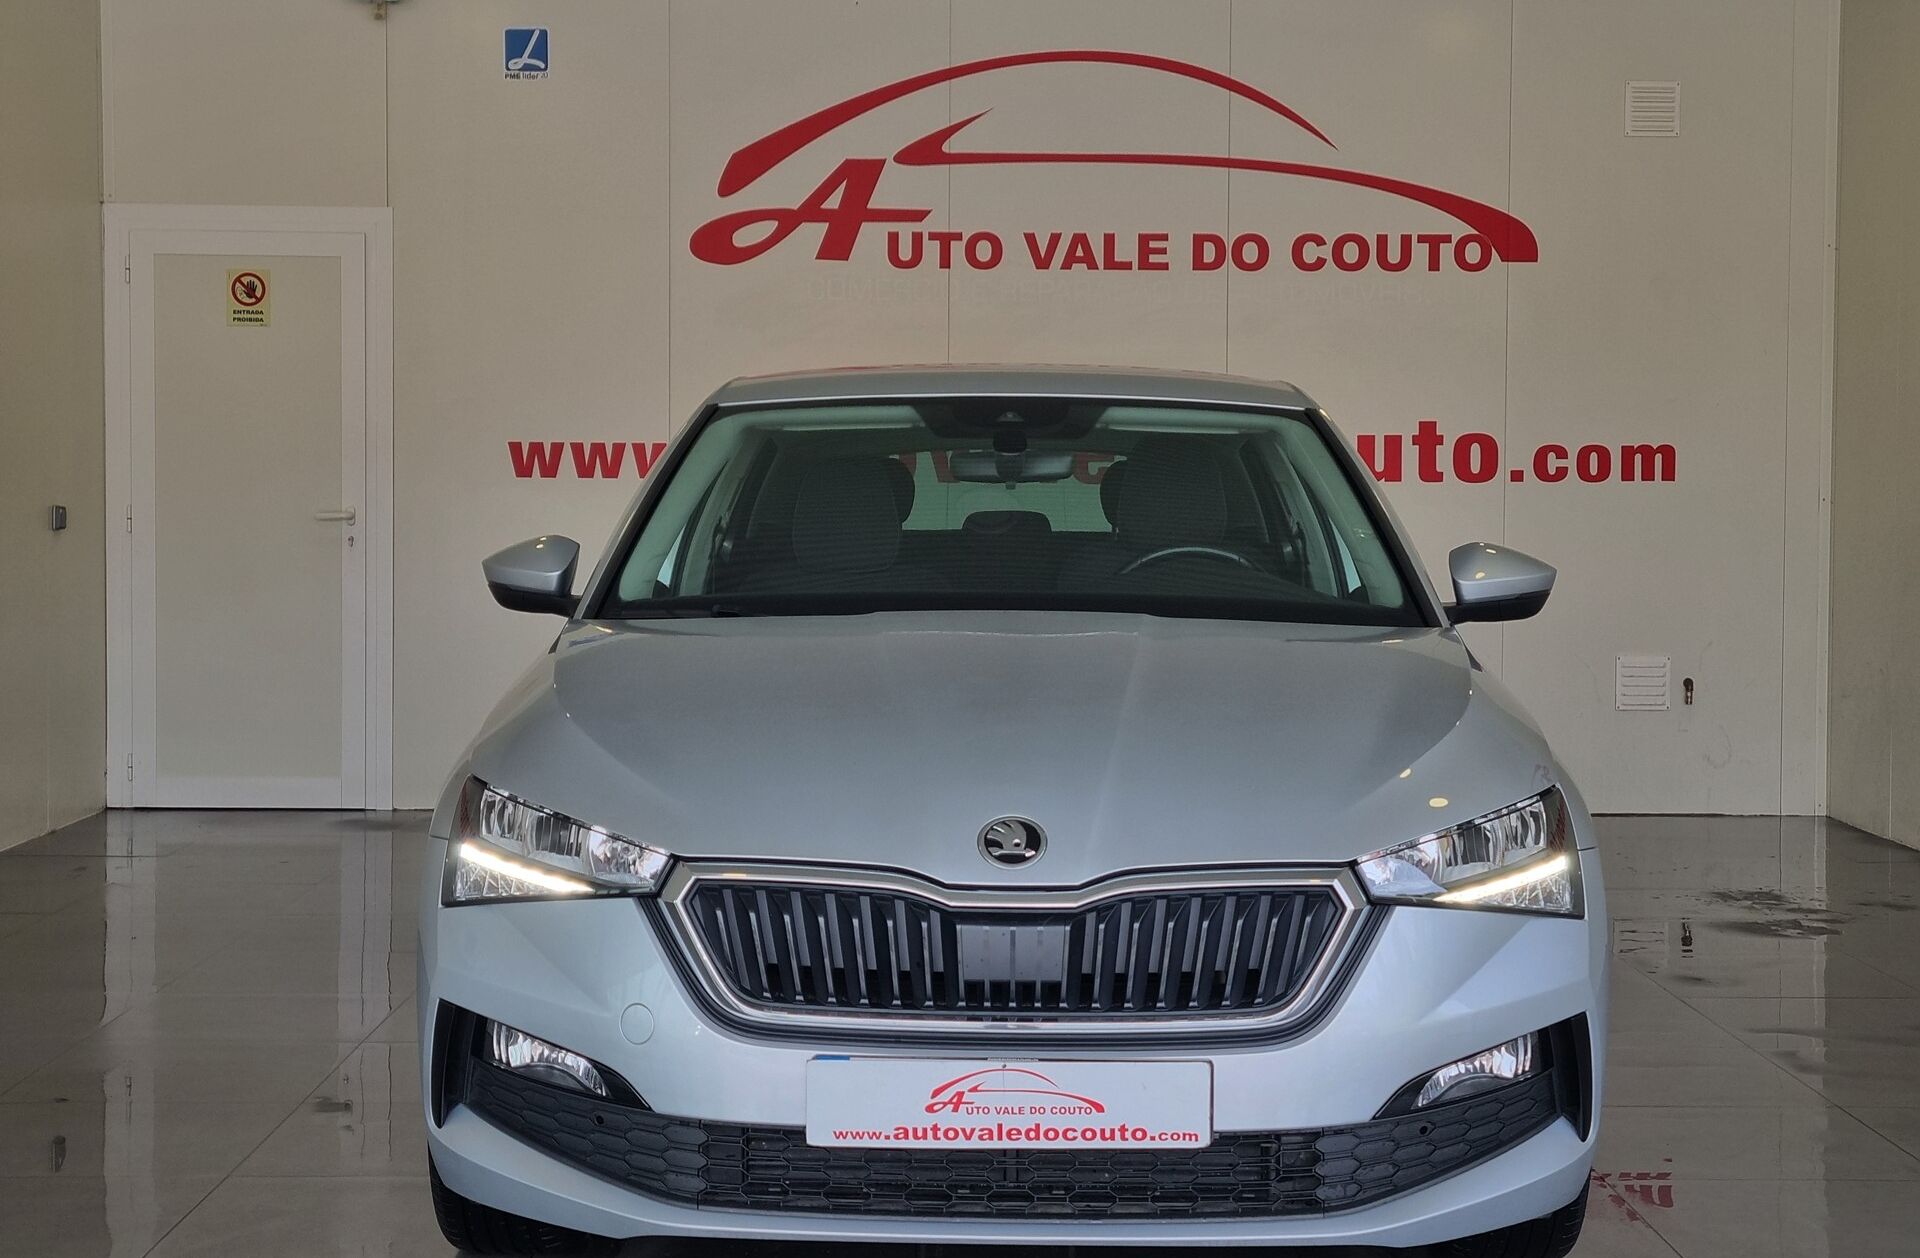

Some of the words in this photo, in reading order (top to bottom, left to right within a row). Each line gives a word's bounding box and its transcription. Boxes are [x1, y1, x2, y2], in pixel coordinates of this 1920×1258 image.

[690, 158, 1003, 271] AUTO
[1023, 231, 1170, 272] VALE
[1191, 232, 1270, 272] DO
[1290, 232, 1494, 273] COUTO
[925, 1090, 991, 1116] AUTO
[995, 1105, 1024, 1116] VALE
[1029, 1105, 1047, 1116] DO
[1050, 1105, 1094, 1116] COUTO
[832, 1122, 1200, 1142] www.autovaledocouto.com
